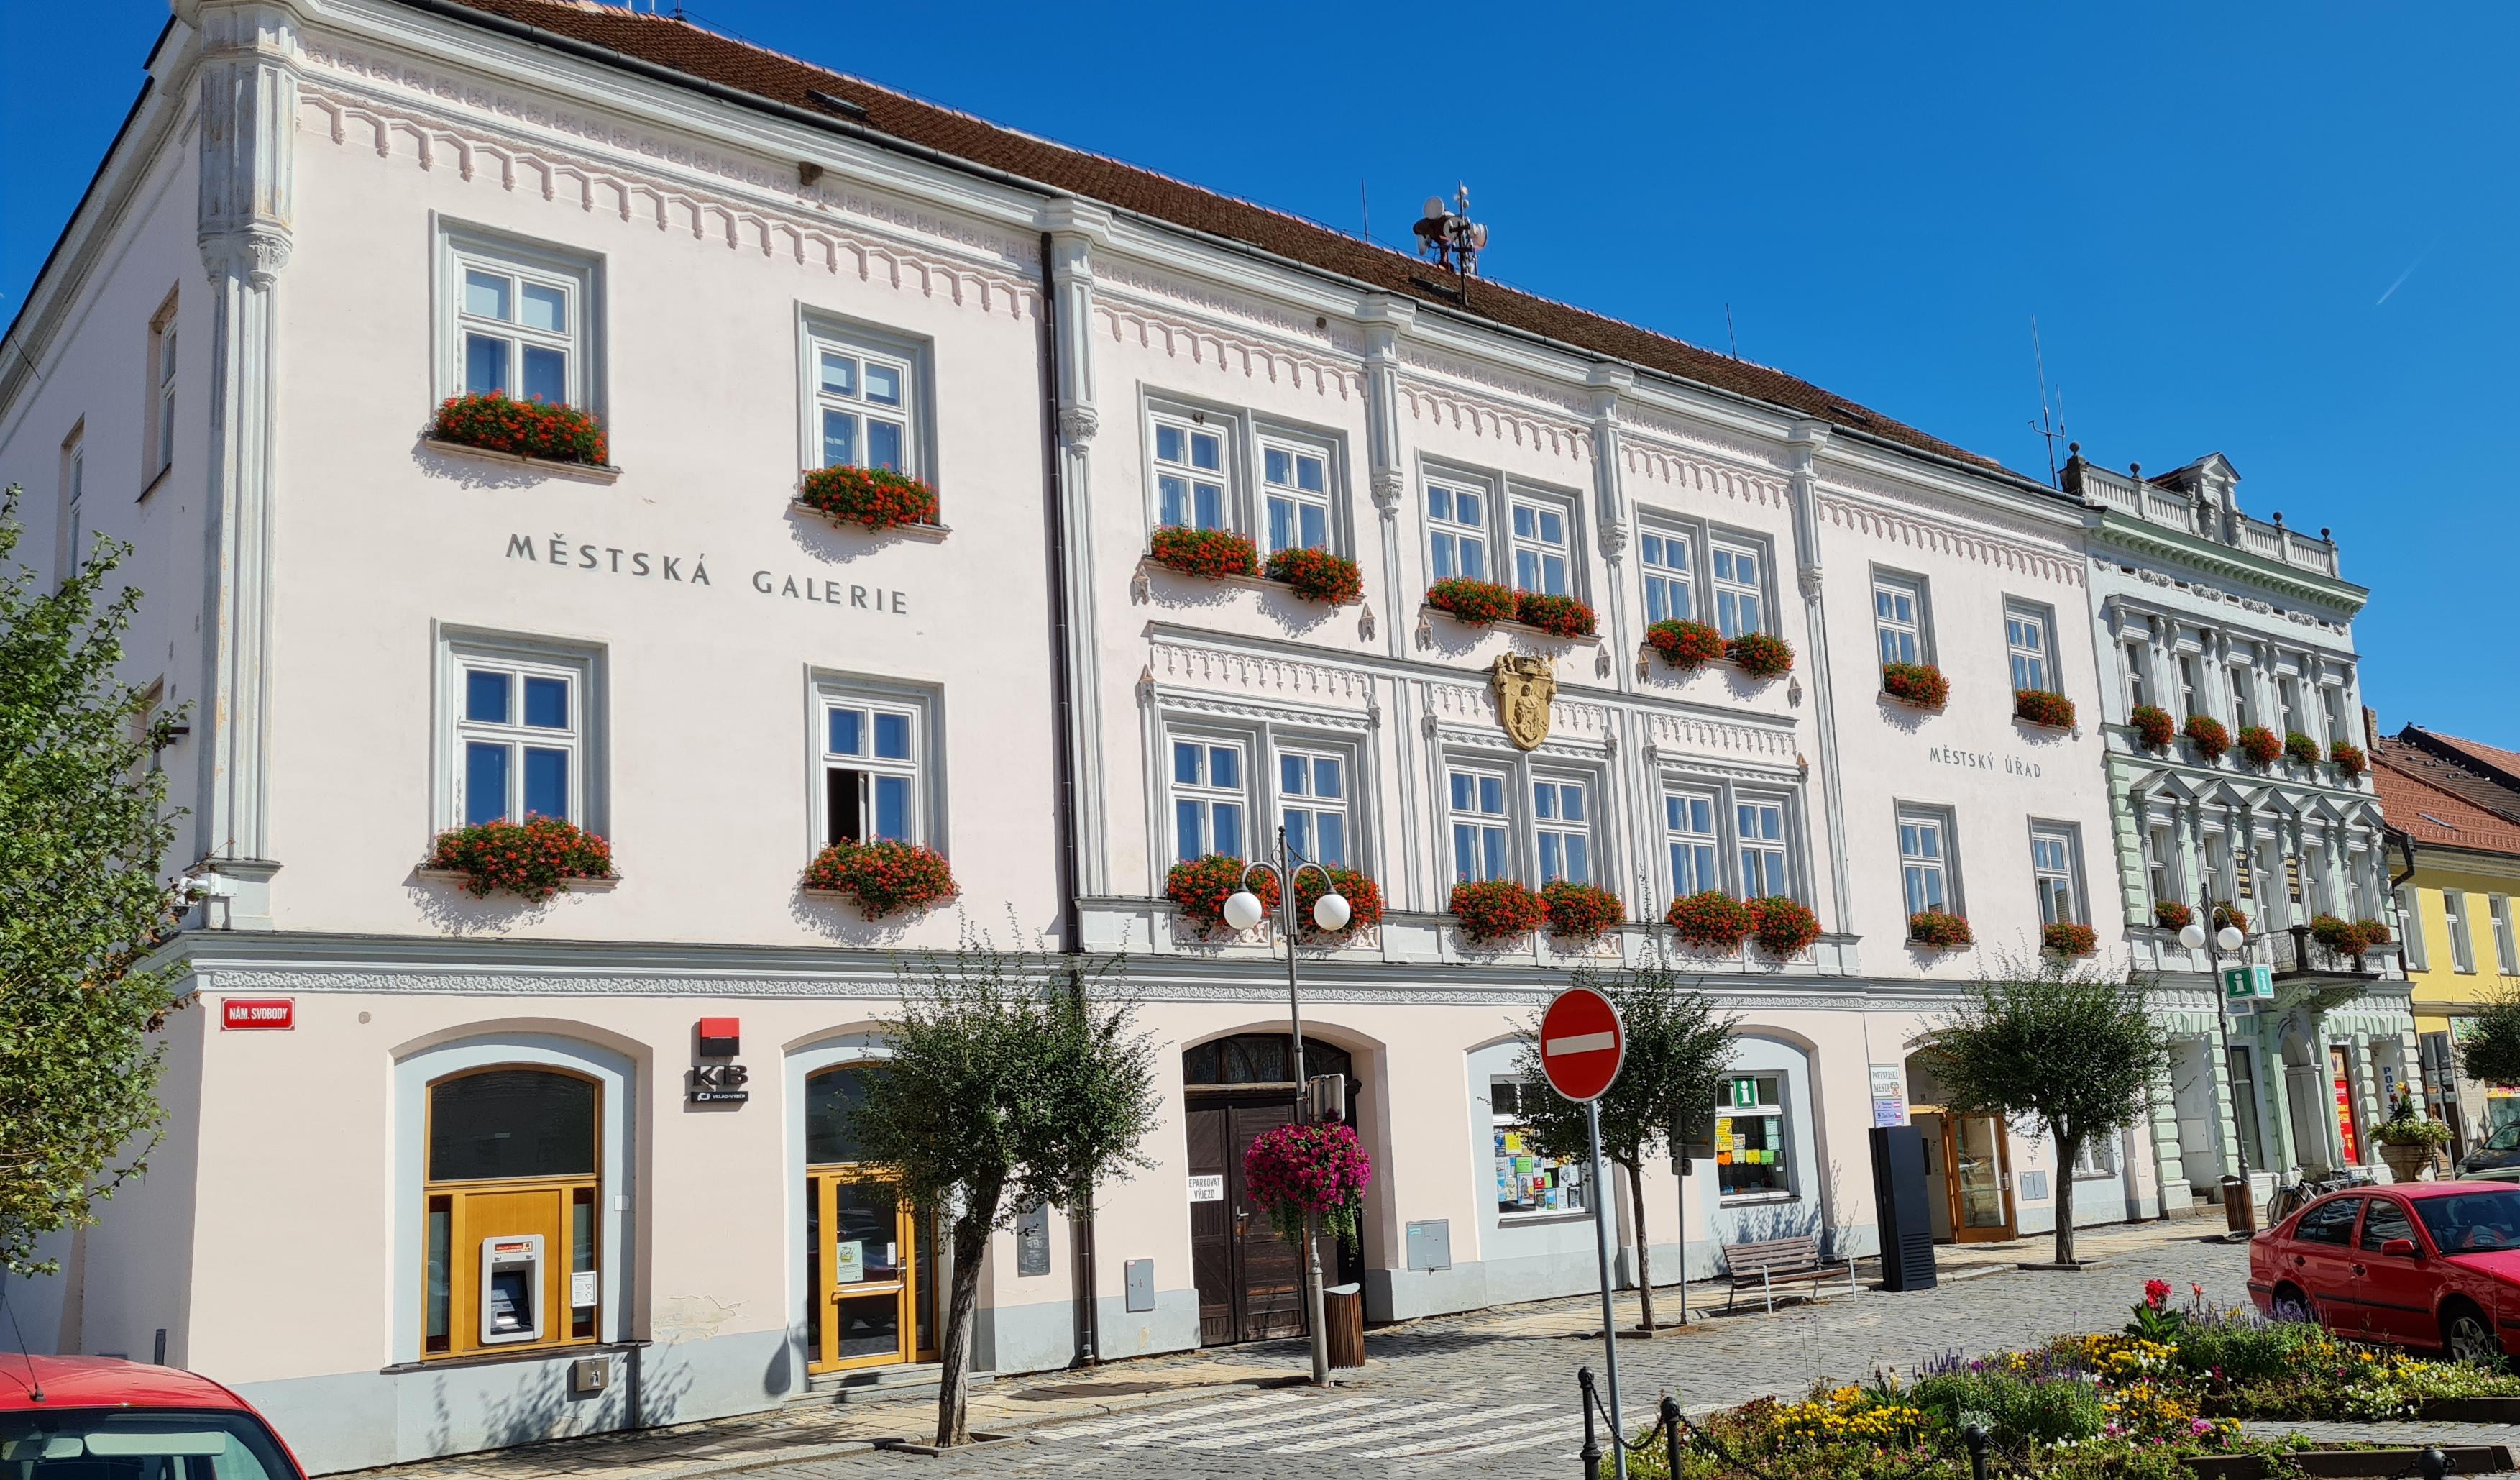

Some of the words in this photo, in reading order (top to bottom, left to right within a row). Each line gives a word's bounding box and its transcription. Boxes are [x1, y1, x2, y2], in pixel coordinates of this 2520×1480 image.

[505, 531, 711, 586] MĚSTSKÁ
[752, 570, 907, 615] GALERIE
[1929, 744, 1994, 771] MĚSTSKÝ
[2004, 754, 2041, 778] ÚŘAD
[229, 1006, 250, 1020] NÁM.
[251, 1008, 288, 1020] SVOBODY
[693, 1065, 748, 1086] KB
[1188, 1177, 1221, 1188] EPARKOVAT
[1193, 1187, 1215, 1200] VÝJEZD
